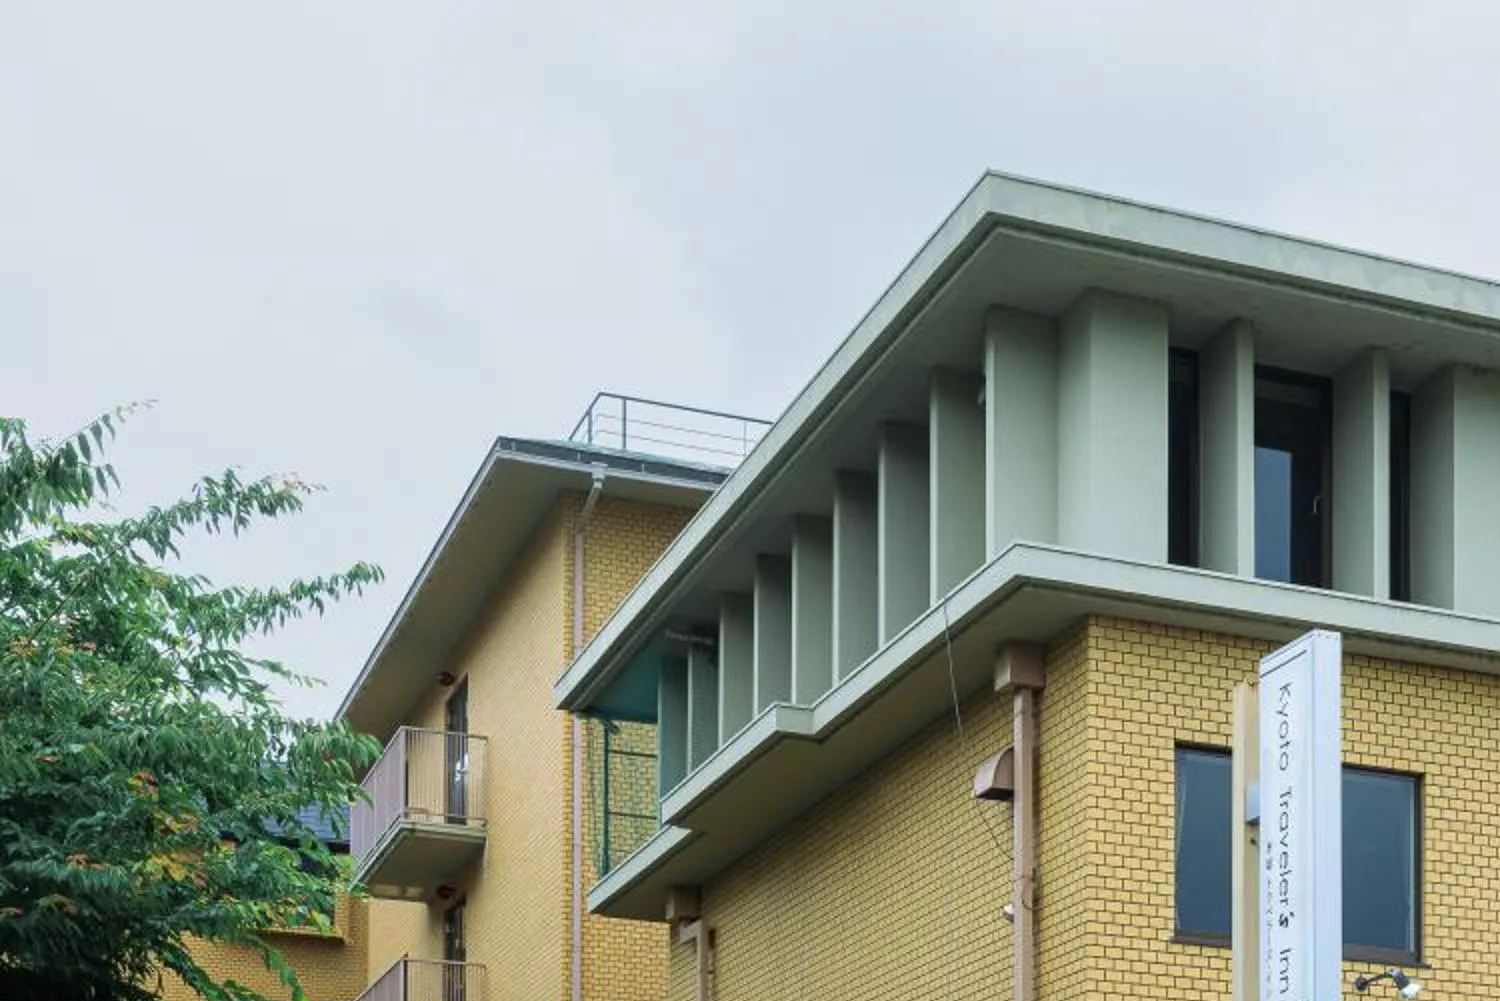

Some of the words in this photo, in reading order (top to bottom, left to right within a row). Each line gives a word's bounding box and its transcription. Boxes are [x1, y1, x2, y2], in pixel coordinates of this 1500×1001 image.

[1276, 682, 1292, 771] Kyoto
[1278, 786, 1295, 929] Traveler's
[1279, 948, 1292, 995] Inn
